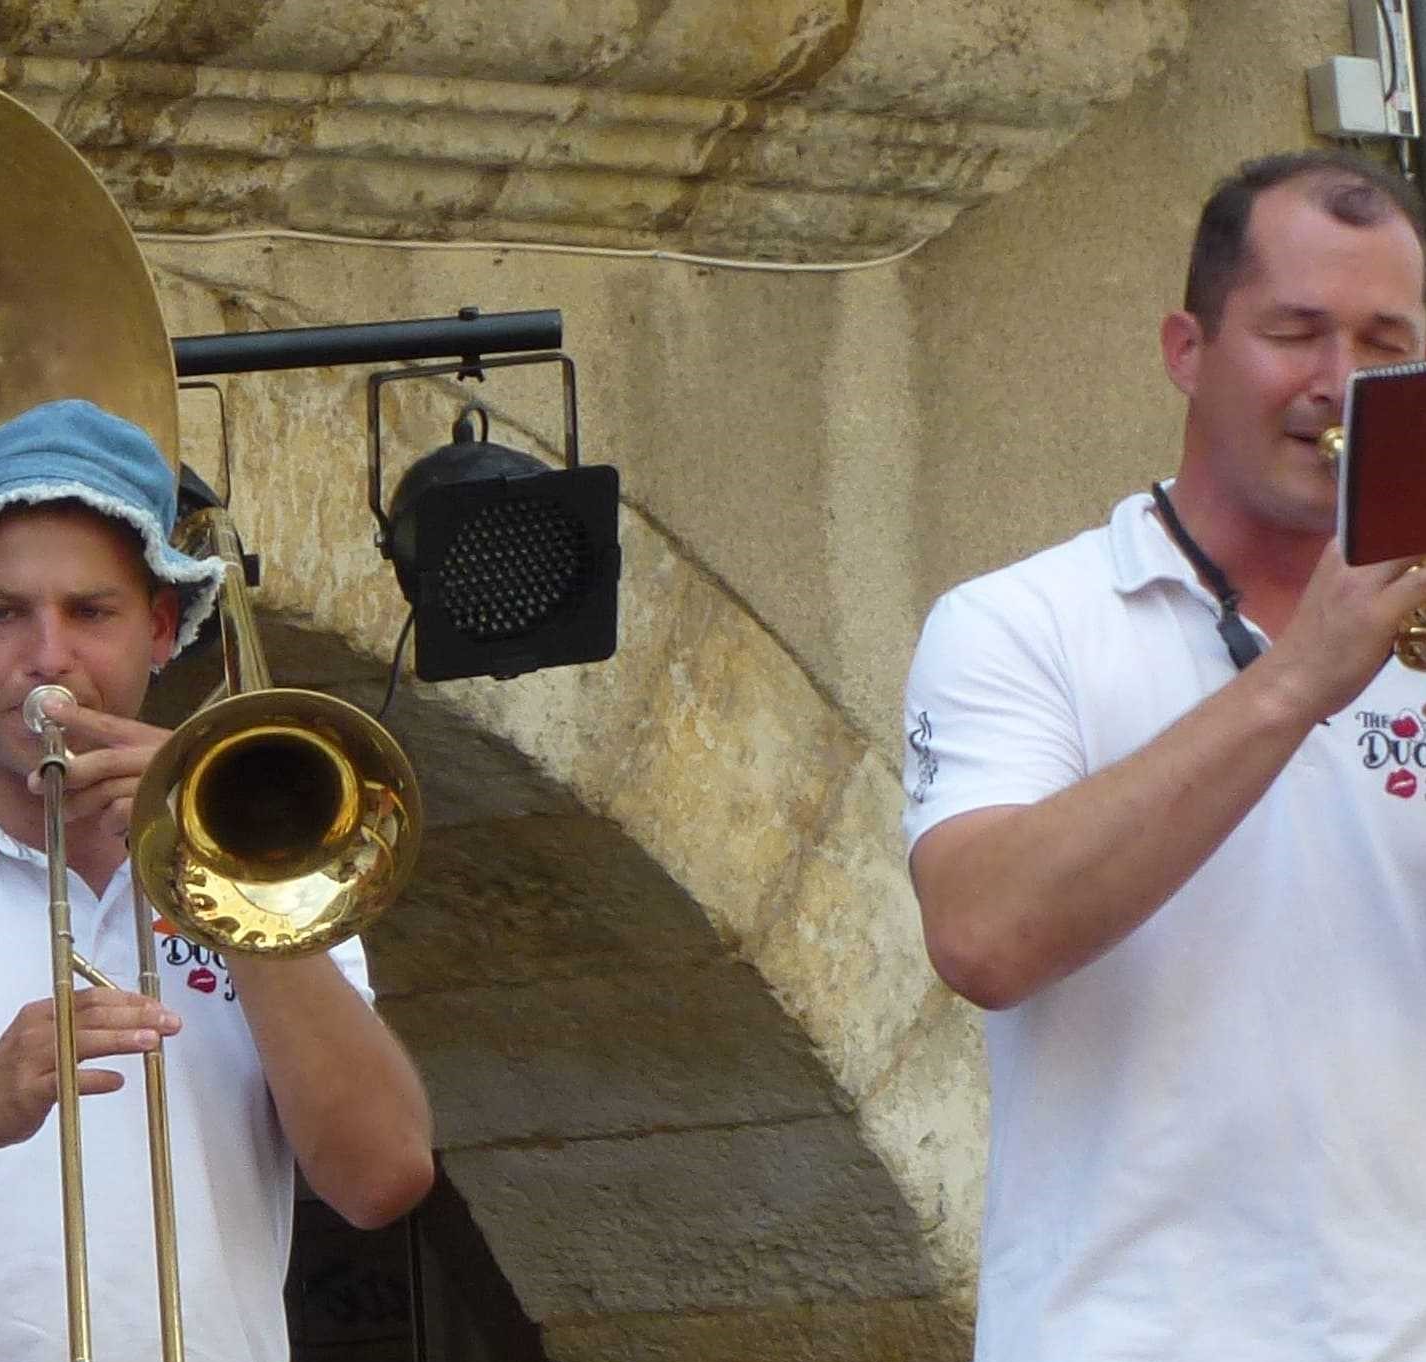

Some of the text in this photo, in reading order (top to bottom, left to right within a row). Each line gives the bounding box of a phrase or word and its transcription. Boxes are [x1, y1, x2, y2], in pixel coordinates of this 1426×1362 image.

[1355, 711, 1388, 728] THE
[1357, 730, 1426, 769] DUC
[161, 935, 228, 970] DUC
